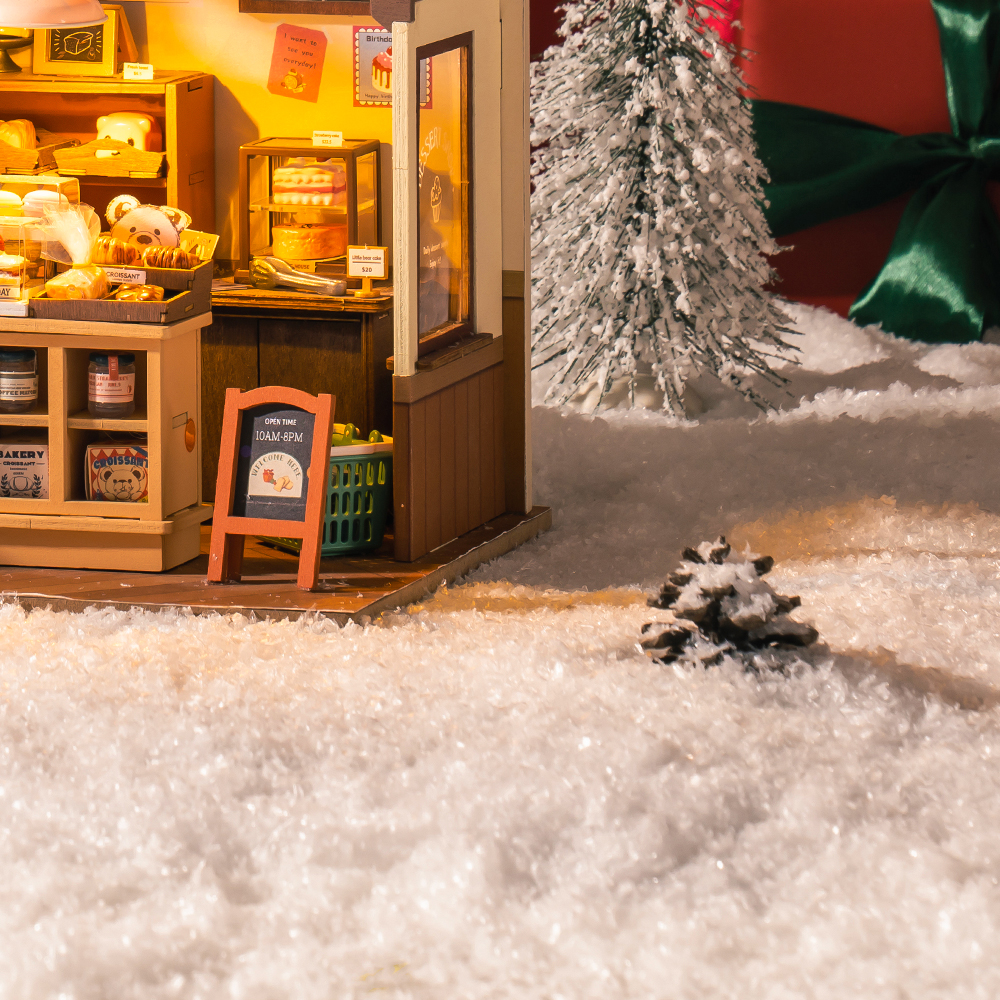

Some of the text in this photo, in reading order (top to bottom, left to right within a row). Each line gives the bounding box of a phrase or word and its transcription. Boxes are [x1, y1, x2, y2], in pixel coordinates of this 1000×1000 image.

[366, 35, 392, 43] Birthda
[287, 46, 314, 58] see you
[283, 57, 317, 70] everyday!
[106, 271, 140, 280] CROISSANT
[264, 417, 297, 427] OPEN TIME
[256, 430, 303, 443] 10AM-8PM
[251, 453, 286, 477] WELCOME
